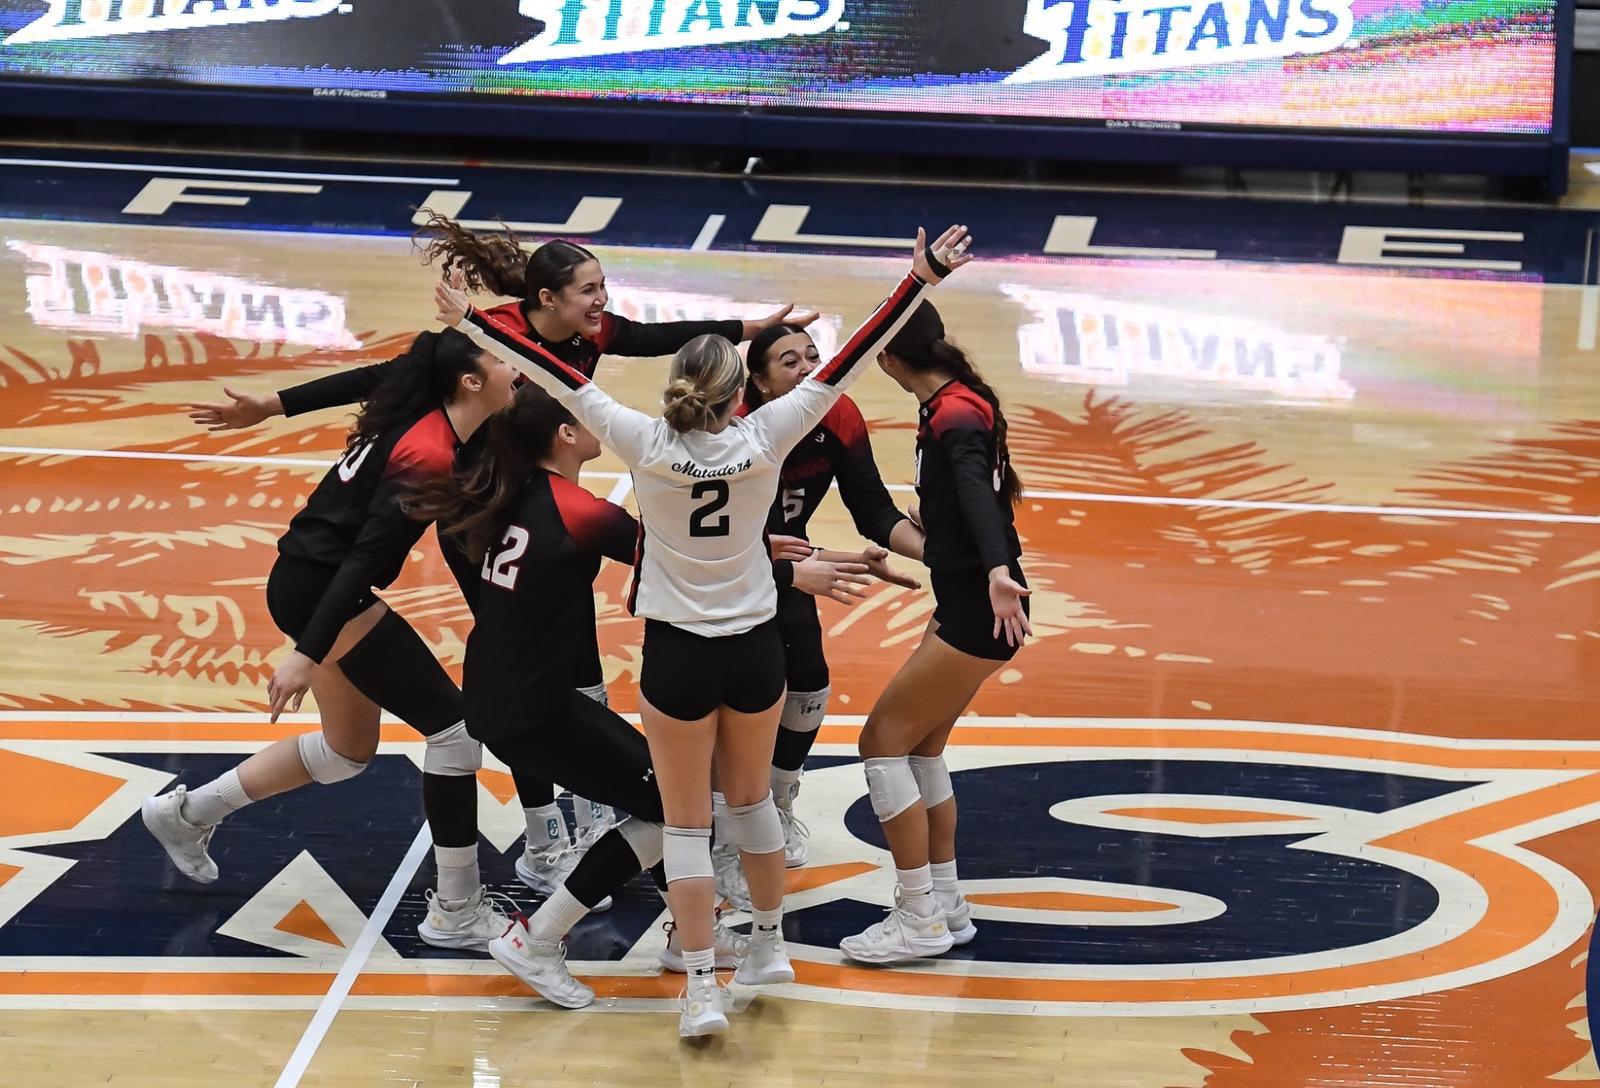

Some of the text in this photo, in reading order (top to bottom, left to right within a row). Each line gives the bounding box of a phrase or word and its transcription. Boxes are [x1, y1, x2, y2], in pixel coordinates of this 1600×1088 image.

[1041, 0, 1340, 65] TITANS
[671, 458, 752, 478] Matadors
[689, 478, 730, 538] 2
[782, 487, 806, 523] 5
